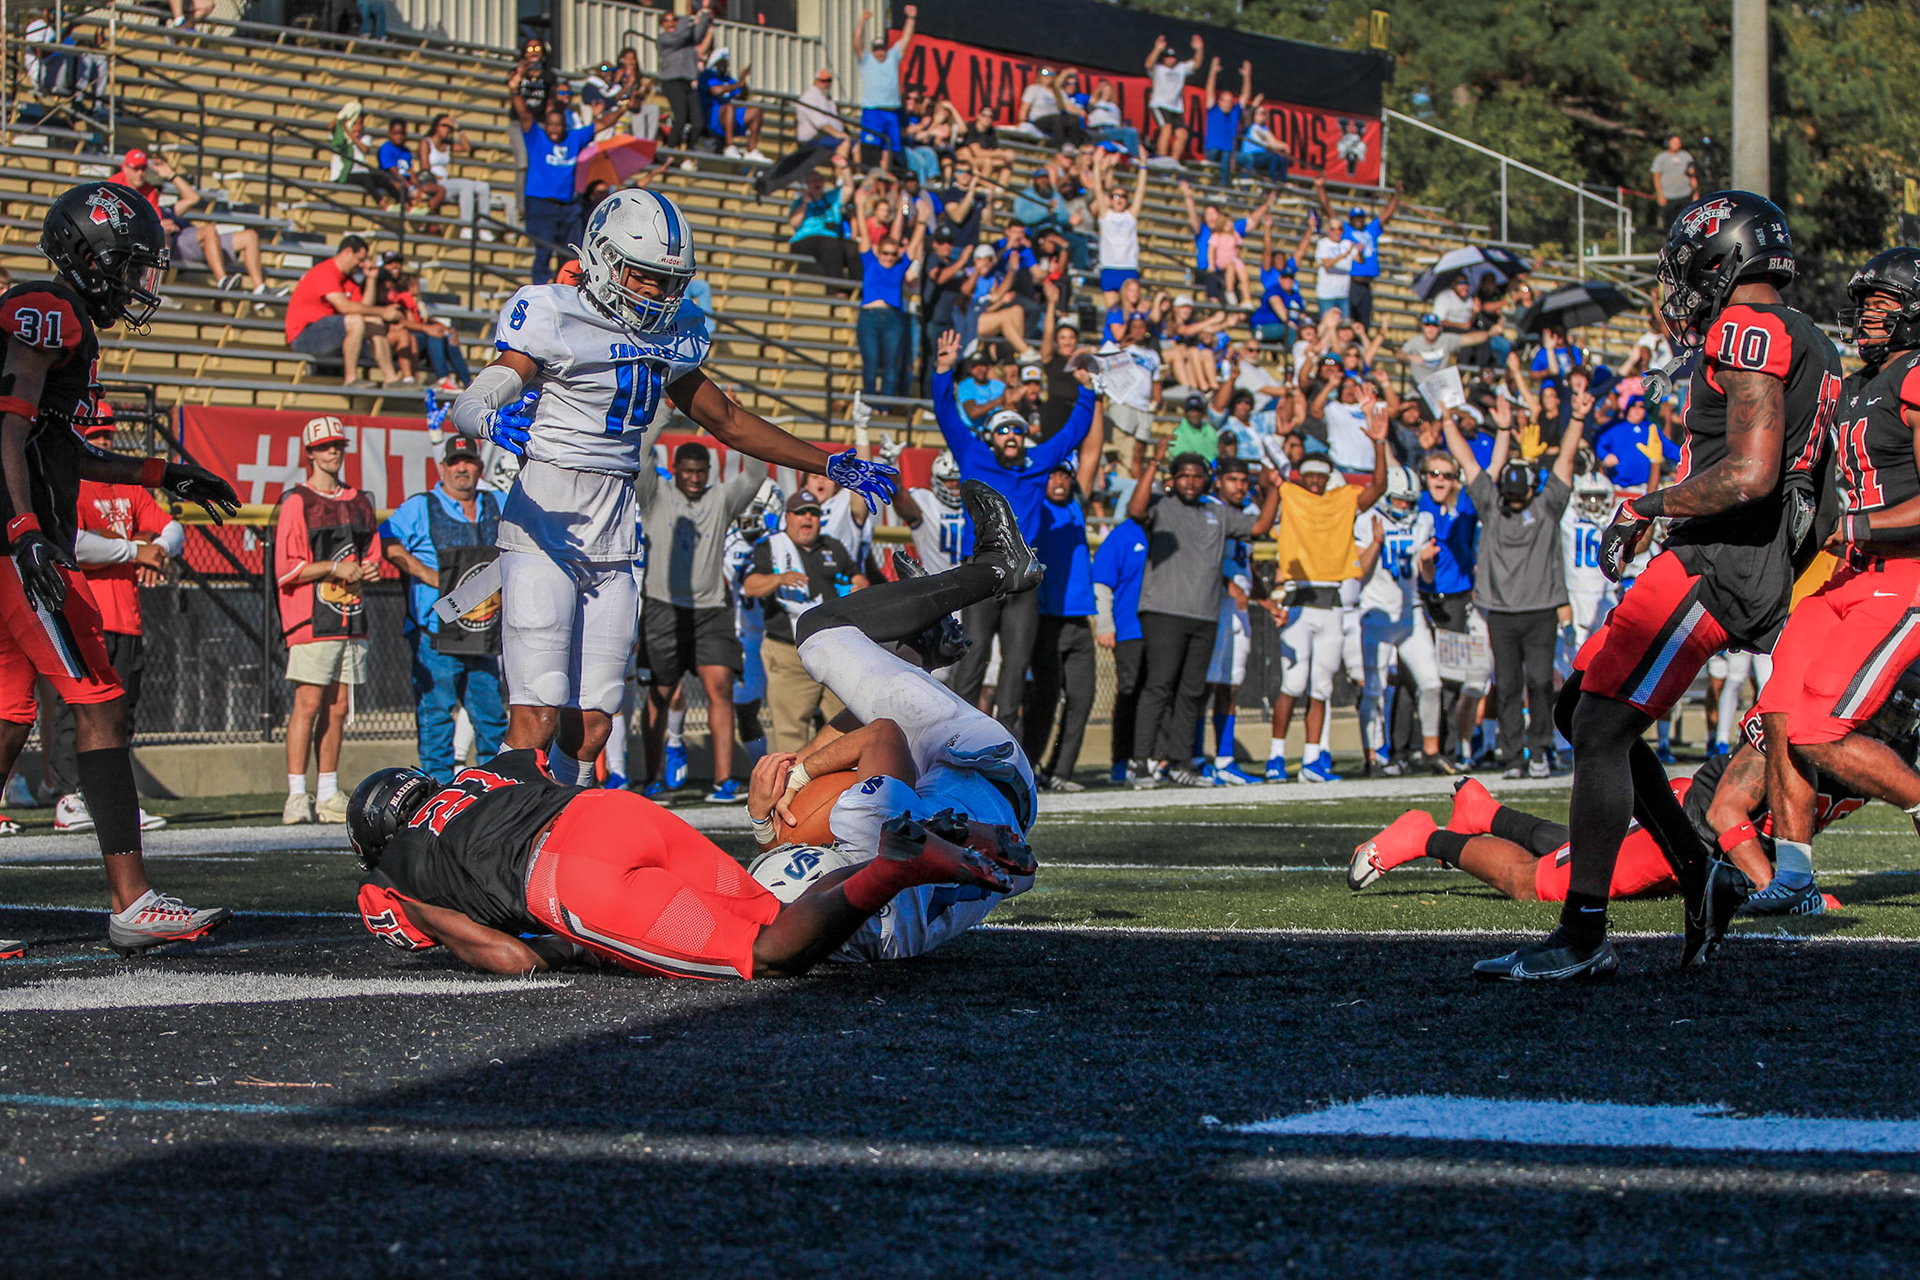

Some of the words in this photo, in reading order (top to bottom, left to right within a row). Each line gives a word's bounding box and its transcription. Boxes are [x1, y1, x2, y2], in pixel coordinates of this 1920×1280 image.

[14, 307, 64, 348] 31
[1716, 321, 1771, 370] 10
[604, 361, 663, 437] 10
[1382, 540, 1414, 580] 45
[1575, 528, 1600, 568] 16
[389, 777, 420, 807] BLAZERS
